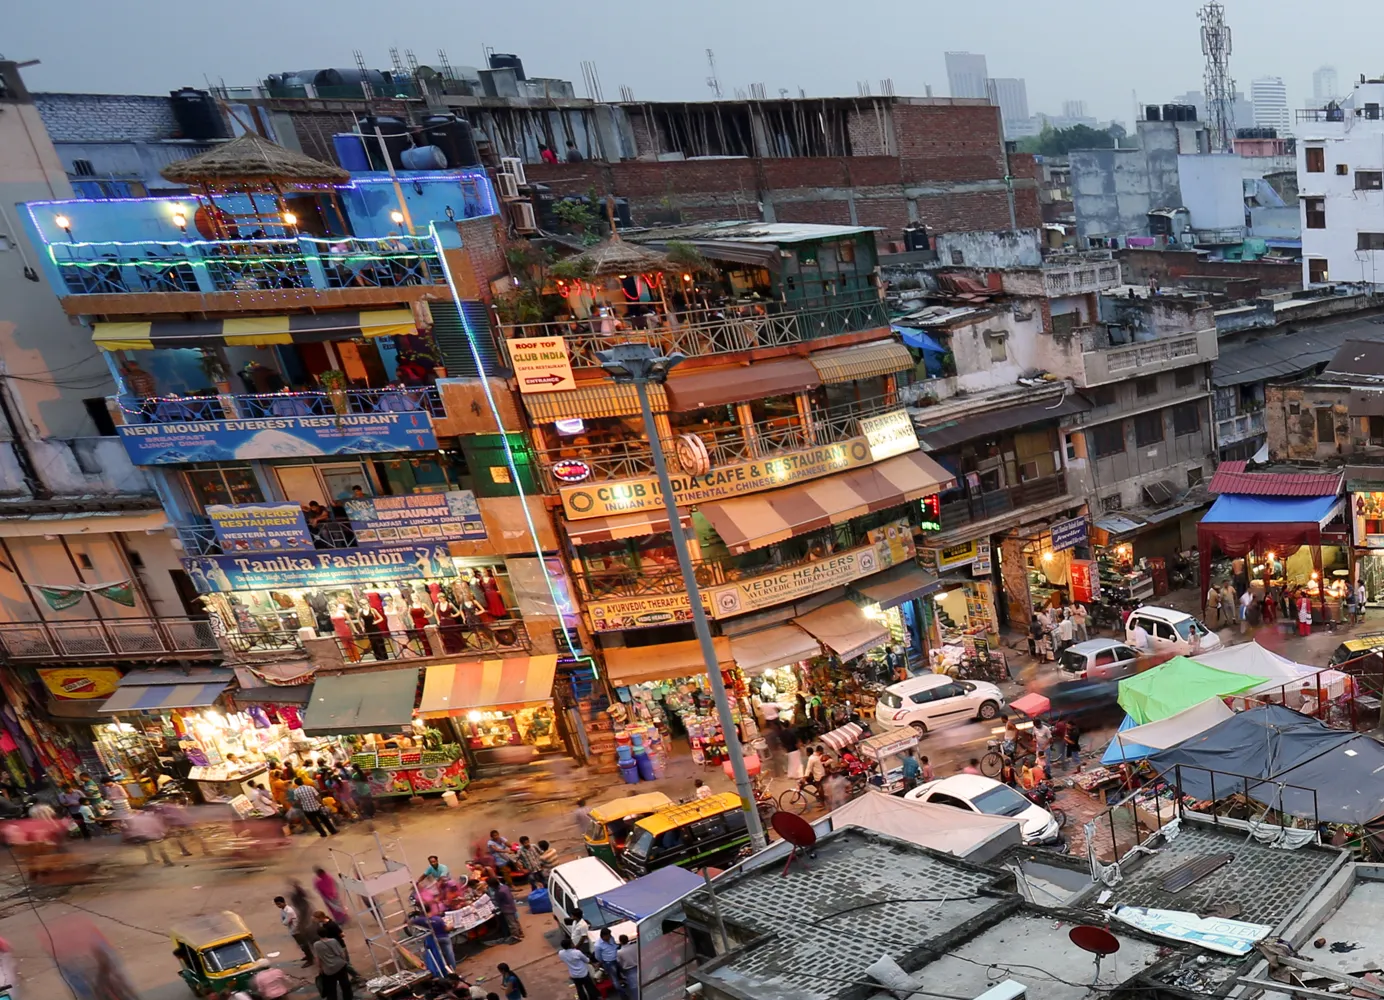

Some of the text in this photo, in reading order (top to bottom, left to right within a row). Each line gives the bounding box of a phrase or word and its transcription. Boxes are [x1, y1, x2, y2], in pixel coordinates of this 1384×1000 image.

[513, 351, 566, 362] CLUB INDIA
[123, 414, 399, 437] NEW MOUNT EVEREST RESTAURANT
[863, 411, 907, 433] BREAKFAST
[138, 439, 217, 450] LUNCH DINNER
[145, 434, 206, 443] BREAKFAST
[556, 466, 585, 476] OPEN
[597, 483, 646, 501] CLUB
[704, 466, 745, 487] CAFE
[750, 464, 762, 477] &
[764, 443, 849, 475] RESTAURANT
[604, 499, 645, 511] INDIAN
[736, 476, 776, 492] CHINESE
[787, 465, 827, 482] JAPANESE
[828, 459, 849, 470] FOOD
[211, 508, 300, 520] MOUNT EVEREST
[376, 507, 450, 520] RESTAURANT
[367, 515, 466, 529] BREAKFAST LUNCH DINNER
[222, 530, 304, 540] WESTERN BAKERY
[234, 550, 406, 574] Tanika Fashion
[742, 574, 788, 593] VEDIC
[792, 555, 855, 578] HEALERS
[748, 583, 792, 599] AYURVEDIC
[793, 571, 825, 588] THERAPY
[825, 563, 853, 579] CENTRE
[606, 601, 647, 614] AYURVEDIC
[647, 597, 680, 609] THERAPY
[681, 593, 708, 605] CERE
[652, 613, 672, 621] HEALERS
